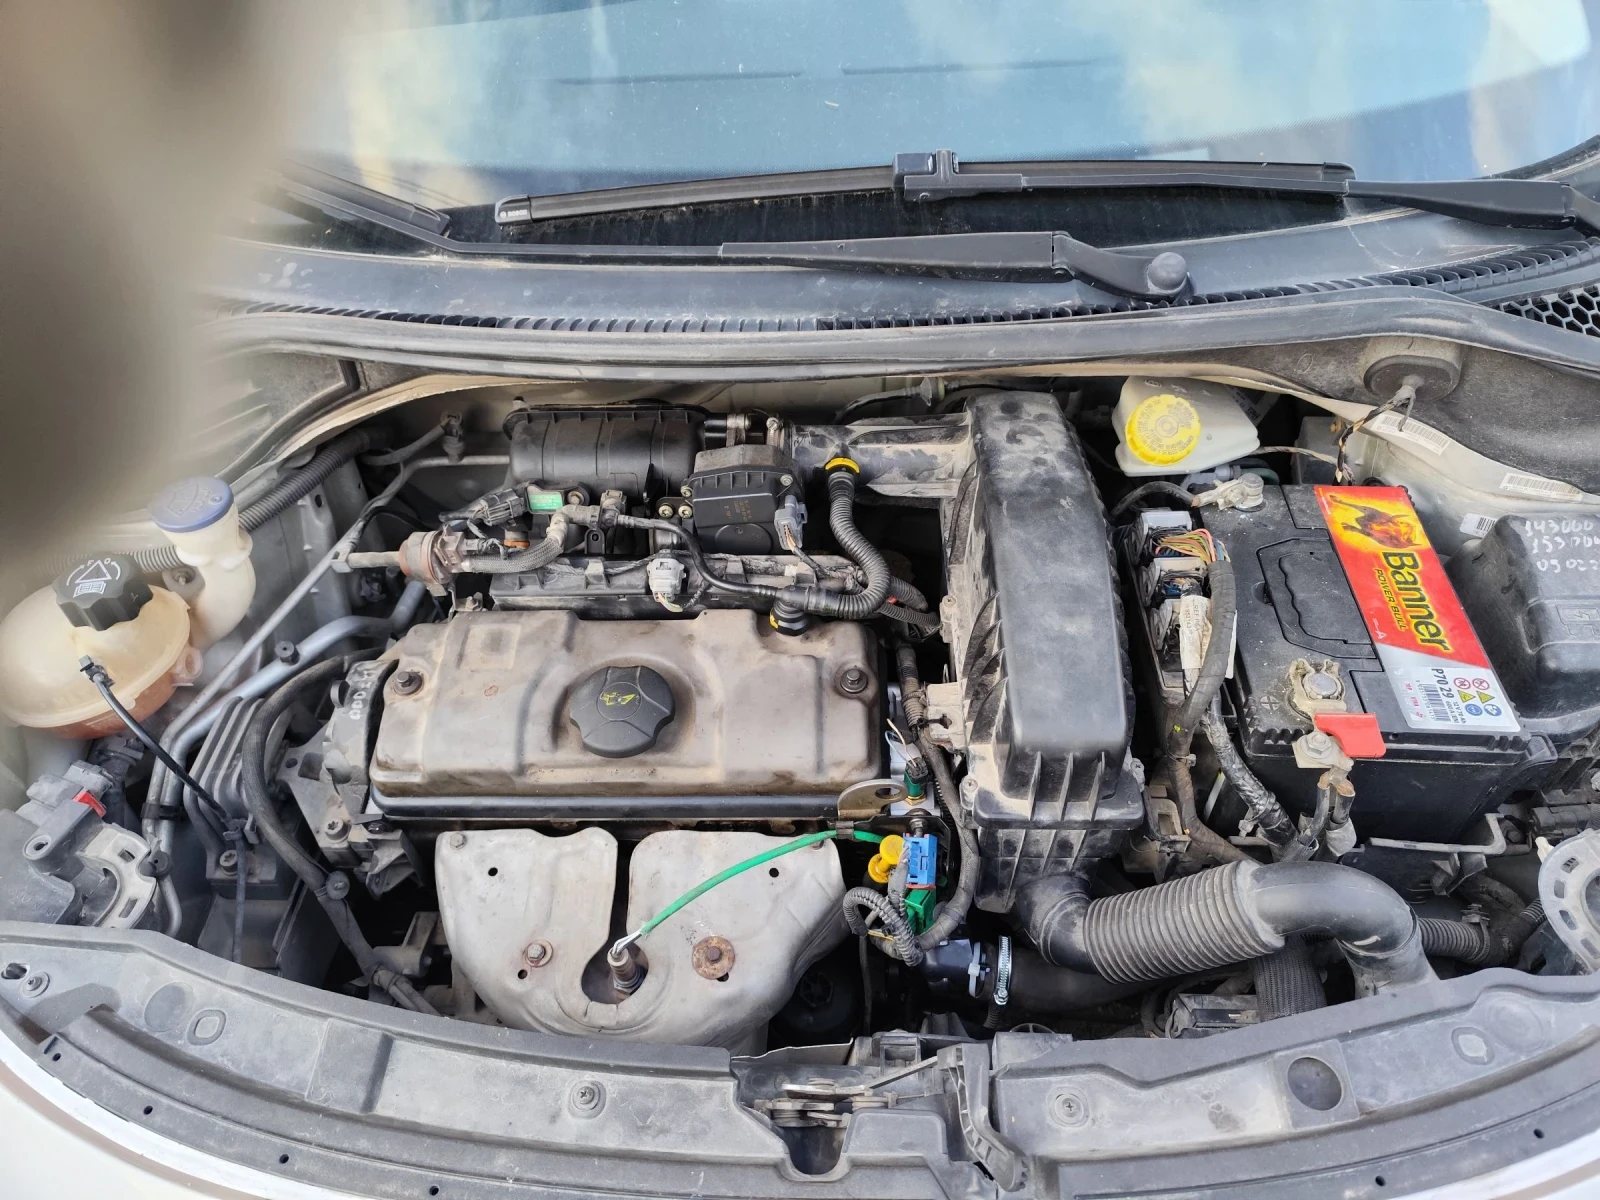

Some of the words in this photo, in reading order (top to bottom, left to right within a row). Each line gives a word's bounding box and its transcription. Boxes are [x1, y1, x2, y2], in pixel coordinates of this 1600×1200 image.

[1375, 568, 1396, 603] POWER
[1391, 605, 1407, 630] BULL
[1382, 552, 1450, 650] Banner
[1431, 668, 1448, 685] P70
[1439, 686, 1455, 699] 29
